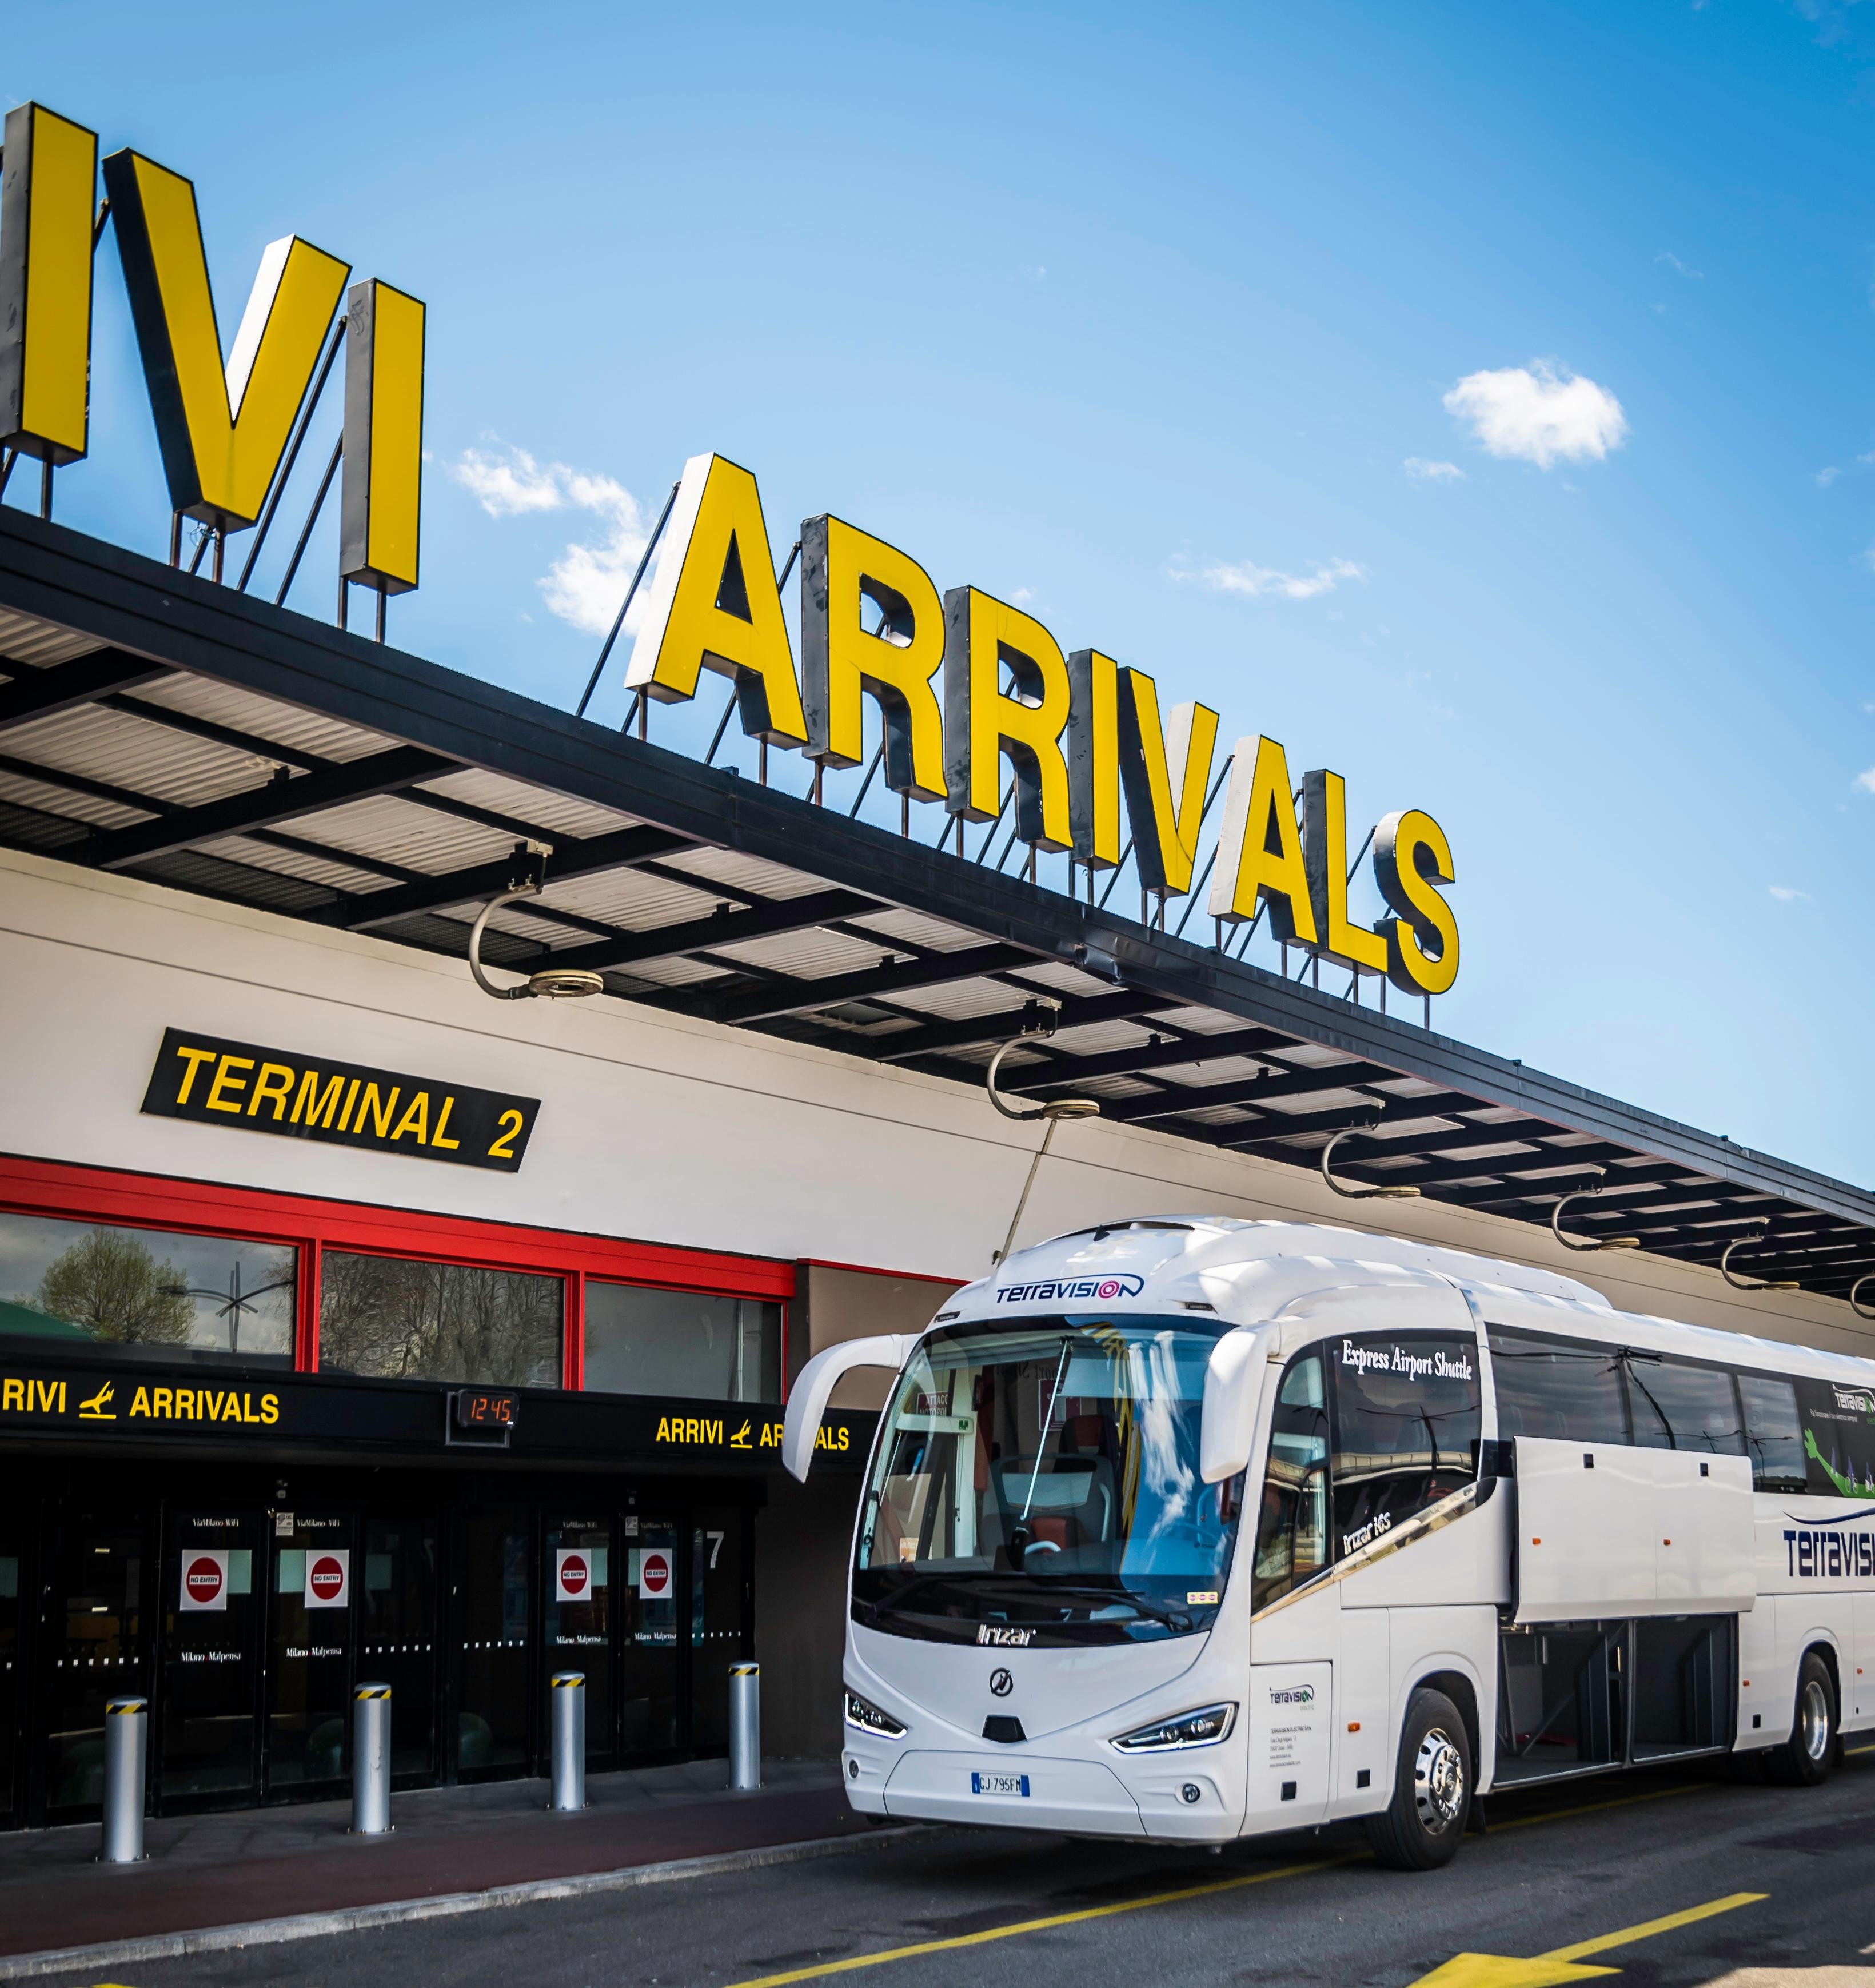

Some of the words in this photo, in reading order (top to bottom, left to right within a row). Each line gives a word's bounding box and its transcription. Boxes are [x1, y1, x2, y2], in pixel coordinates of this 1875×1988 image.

[625, 452, 1461, 996] ARRIVALS
[176, 1047, 460, 1150] TERMINAL
[488, 1109, 524, 1159] 2
[1342, 1339, 1389, 1375] Express
[1391, 1347, 1433, 1382] Airport
[1434, 1352, 1473, 1381] Shuttle
[3, 1378, 66, 1413] RIVI
[129, 1387, 279, 1424] ARRIVALS
[656, 1418, 723, 1444] ARRIVI
[760, 1423, 849, 1451] ARALS
[707, 1531, 724, 1569] 7
[286, 1647, 308, 1658] Milano
[312, 1646, 342, 1658] Malpensa
[556, 1636, 575, 1644] Milano
[635, 1632, 651, 1640] Milano
[181, 1652, 205, 1662] Milano
[208, 1651, 241, 1663] Malpensa
